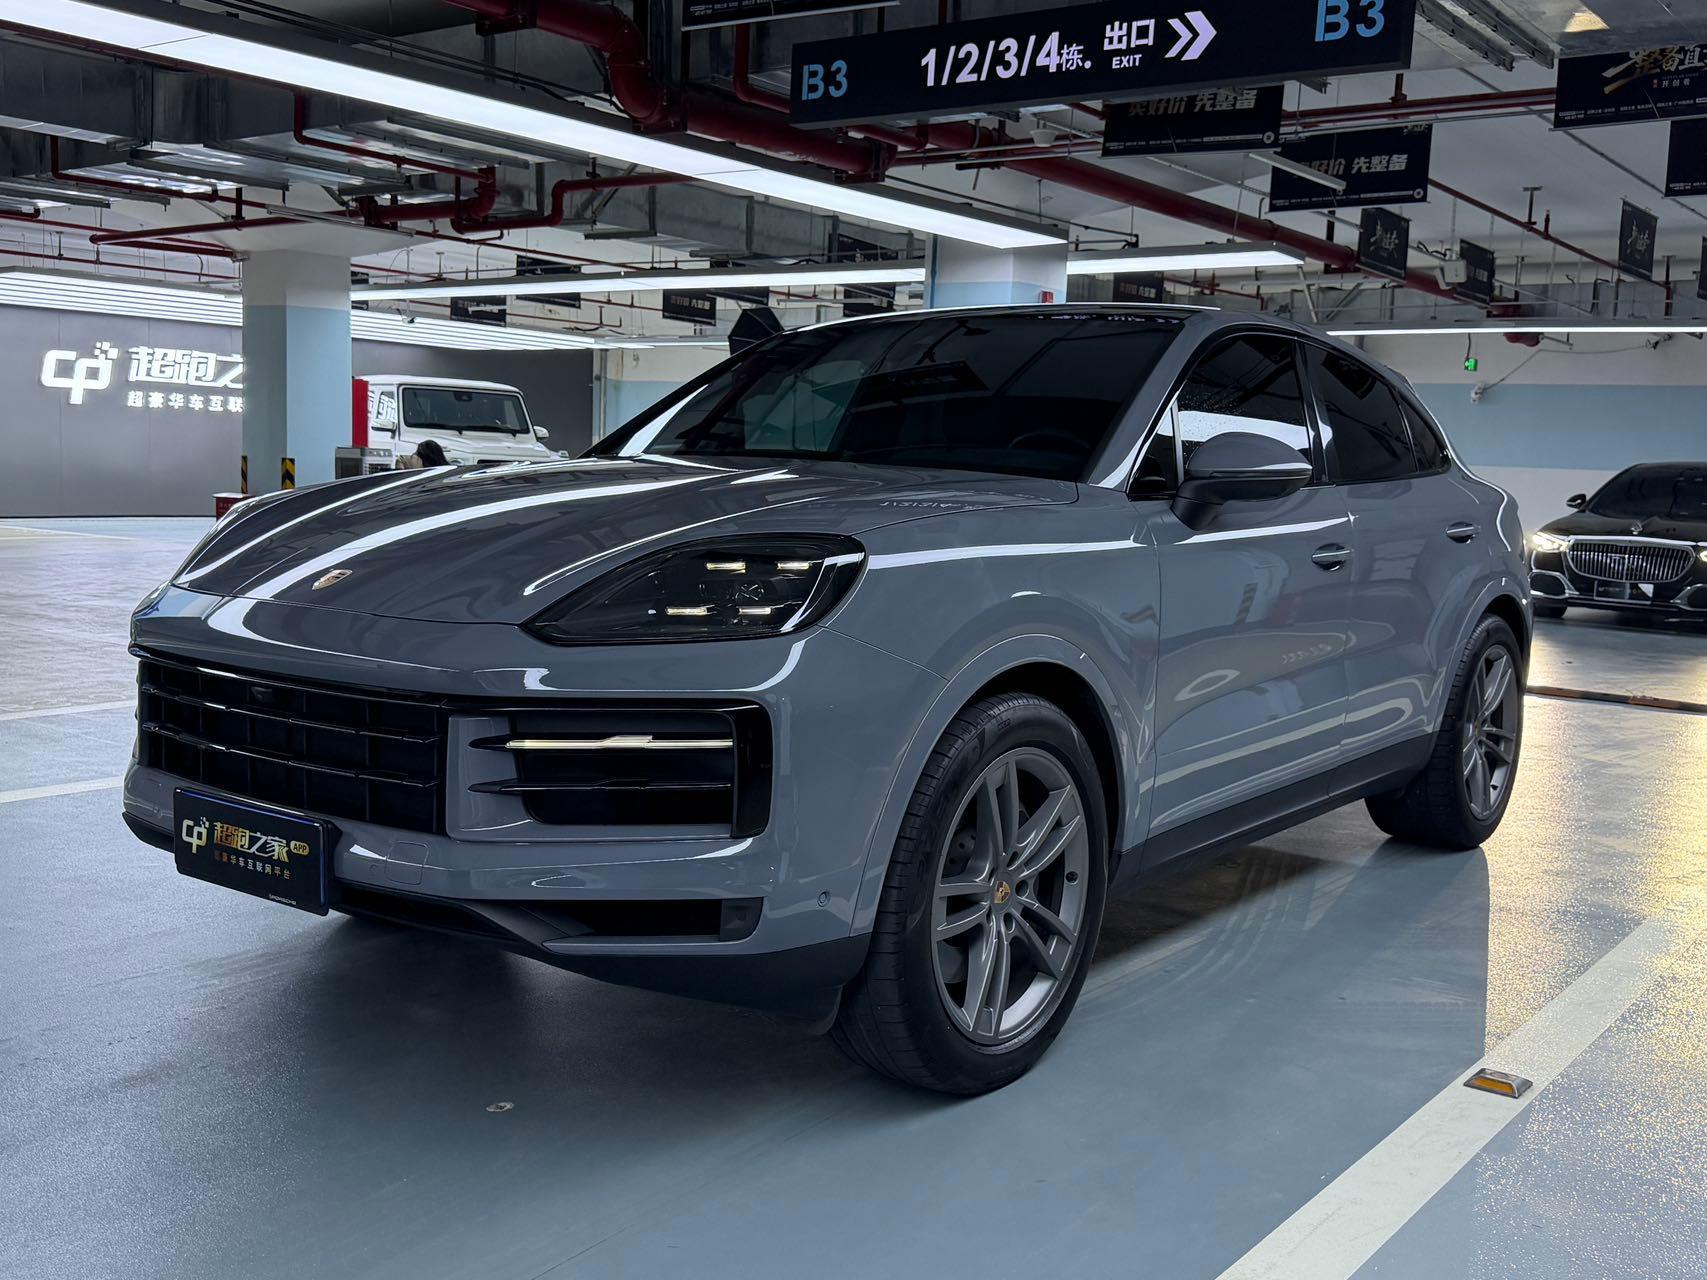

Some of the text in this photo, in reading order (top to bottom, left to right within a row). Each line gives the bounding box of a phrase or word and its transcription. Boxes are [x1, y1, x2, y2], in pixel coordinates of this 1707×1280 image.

[1103, 18, 1155, 51] 出口
[1315, 0, 1385, 42] B3
[801, 59, 848, 101] B3
[1112, 54, 1142, 69] EXIT
[1350, 153, 1409, 175] 先整备
[213, 821, 307, 862] 超跑之家 APP
